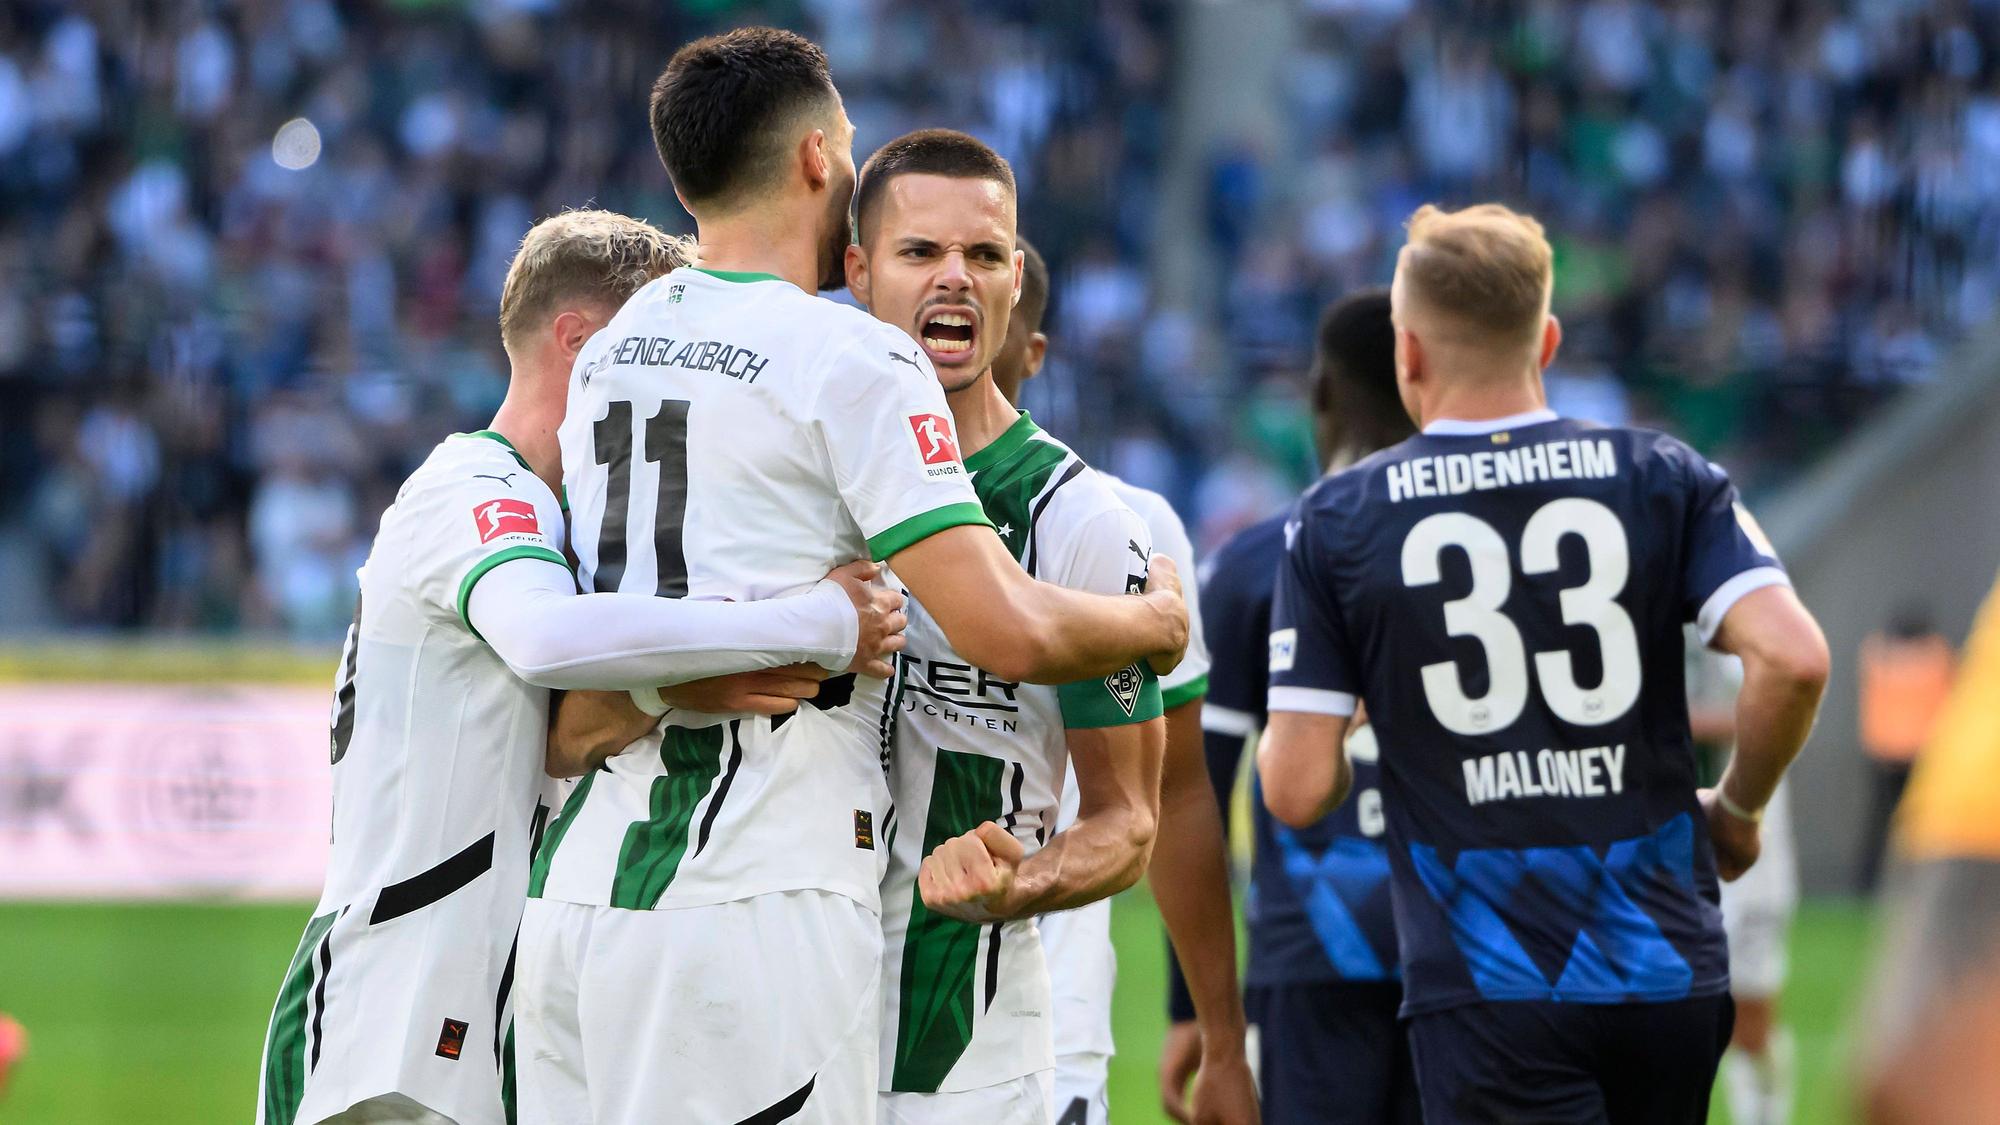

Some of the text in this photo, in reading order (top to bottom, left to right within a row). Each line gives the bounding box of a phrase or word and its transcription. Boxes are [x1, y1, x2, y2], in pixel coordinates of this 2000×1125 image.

[593, 399, 691, 598] 11
[1386, 439, 1616, 502] HEIDENHEIM
[1401, 497, 1642, 736] 33
[1462, 745, 1627, 806] MALONEY
